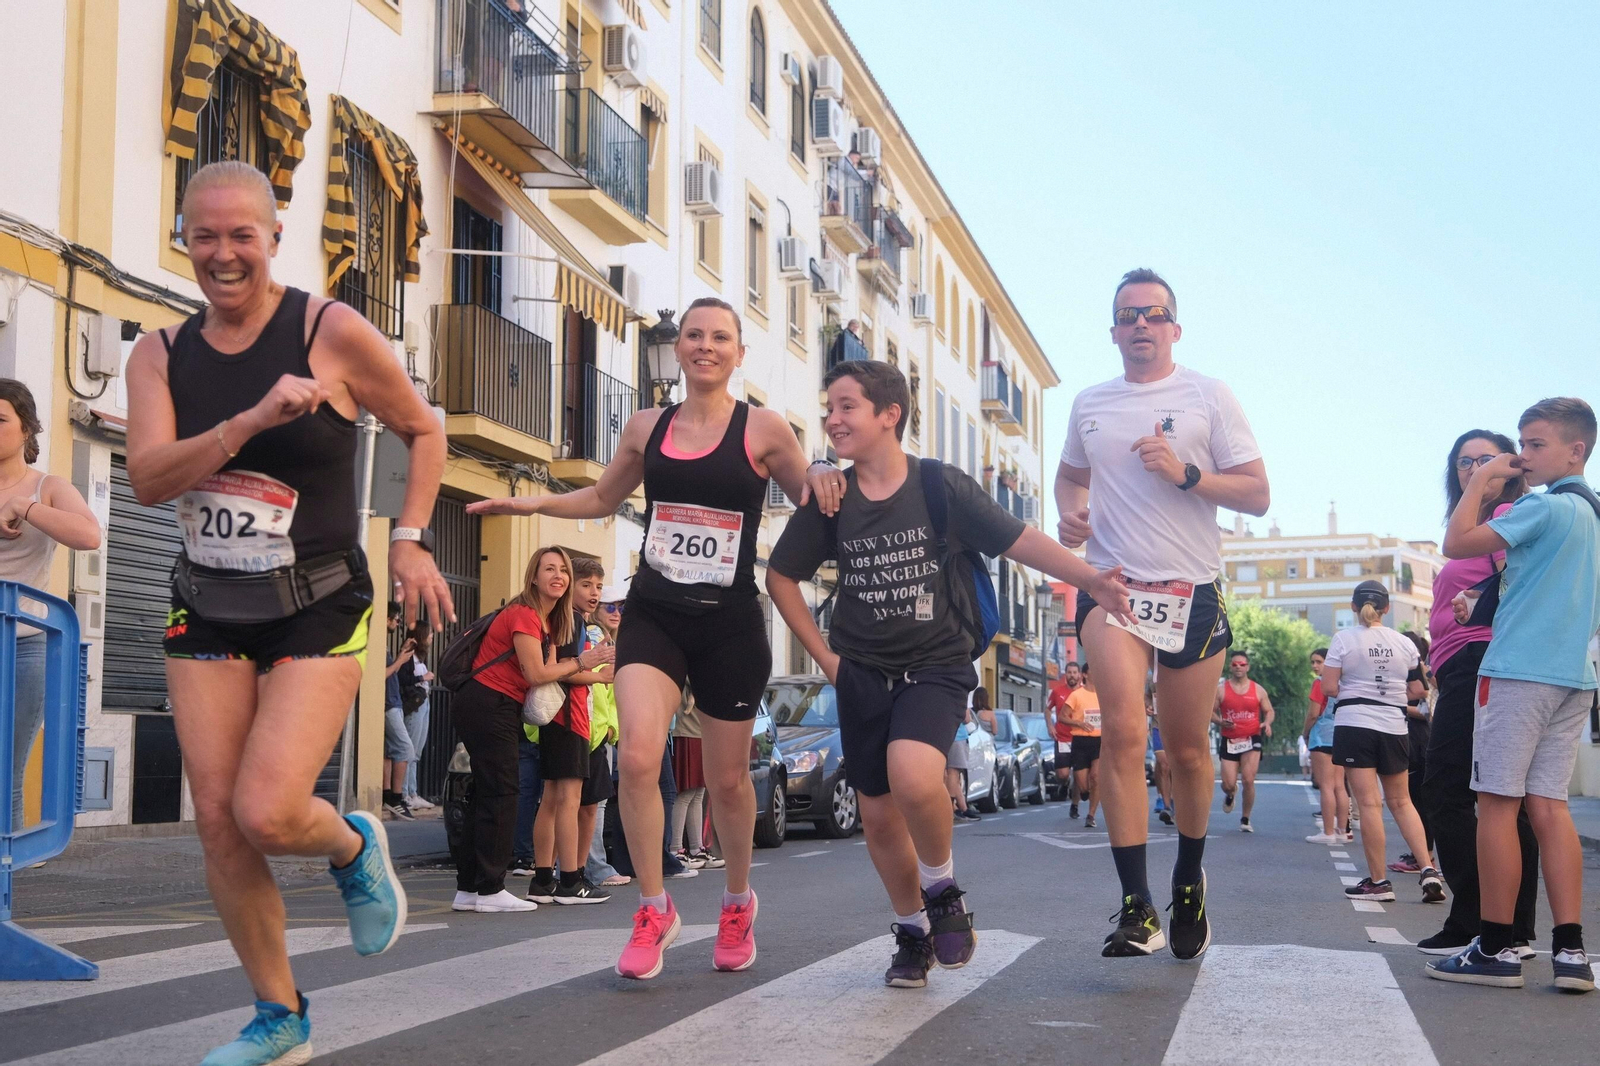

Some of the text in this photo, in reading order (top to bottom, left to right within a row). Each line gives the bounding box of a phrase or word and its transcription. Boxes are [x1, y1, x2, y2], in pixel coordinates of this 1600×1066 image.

[199, 506, 258, 539] 202
[666, 507, 687, 516] CARRERA
[704, 512, 738, 523] AUXILIADORA
[670, 532, 718, 558] 260
[842, 526, 928, 554] NEW YORK
[850, 546, 926, 568] LOS ANGELES
[844, 560, 939, 586] LOS ANGELES
[858, 582, 926, 604] NEW YORK
[918, 598, 930, 606] JFK
[1128, 598, 1168, 624] 135
